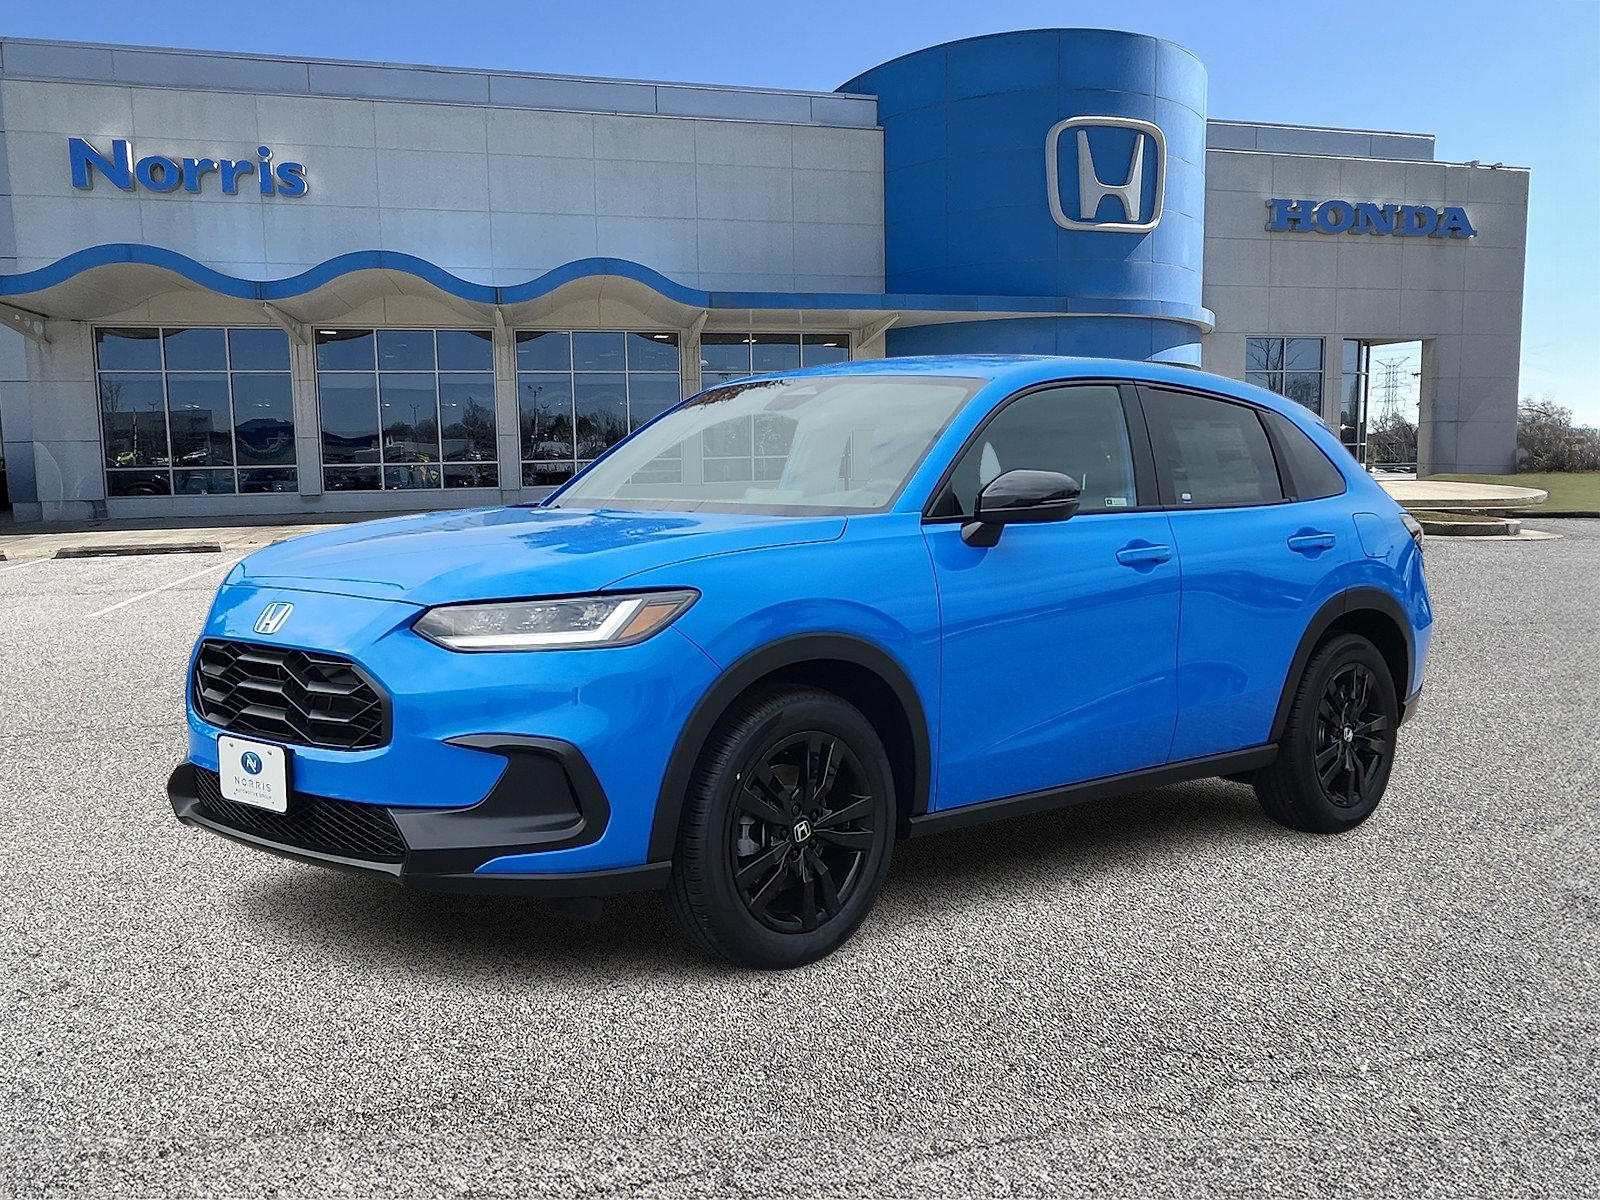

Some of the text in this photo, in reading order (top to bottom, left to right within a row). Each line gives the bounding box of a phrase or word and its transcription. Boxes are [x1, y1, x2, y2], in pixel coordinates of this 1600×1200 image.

[68, 137, 308, 197] Norris
[1265, 198, 1477, 238] HONDA
[234, 776, 272, 793] NORRIS
